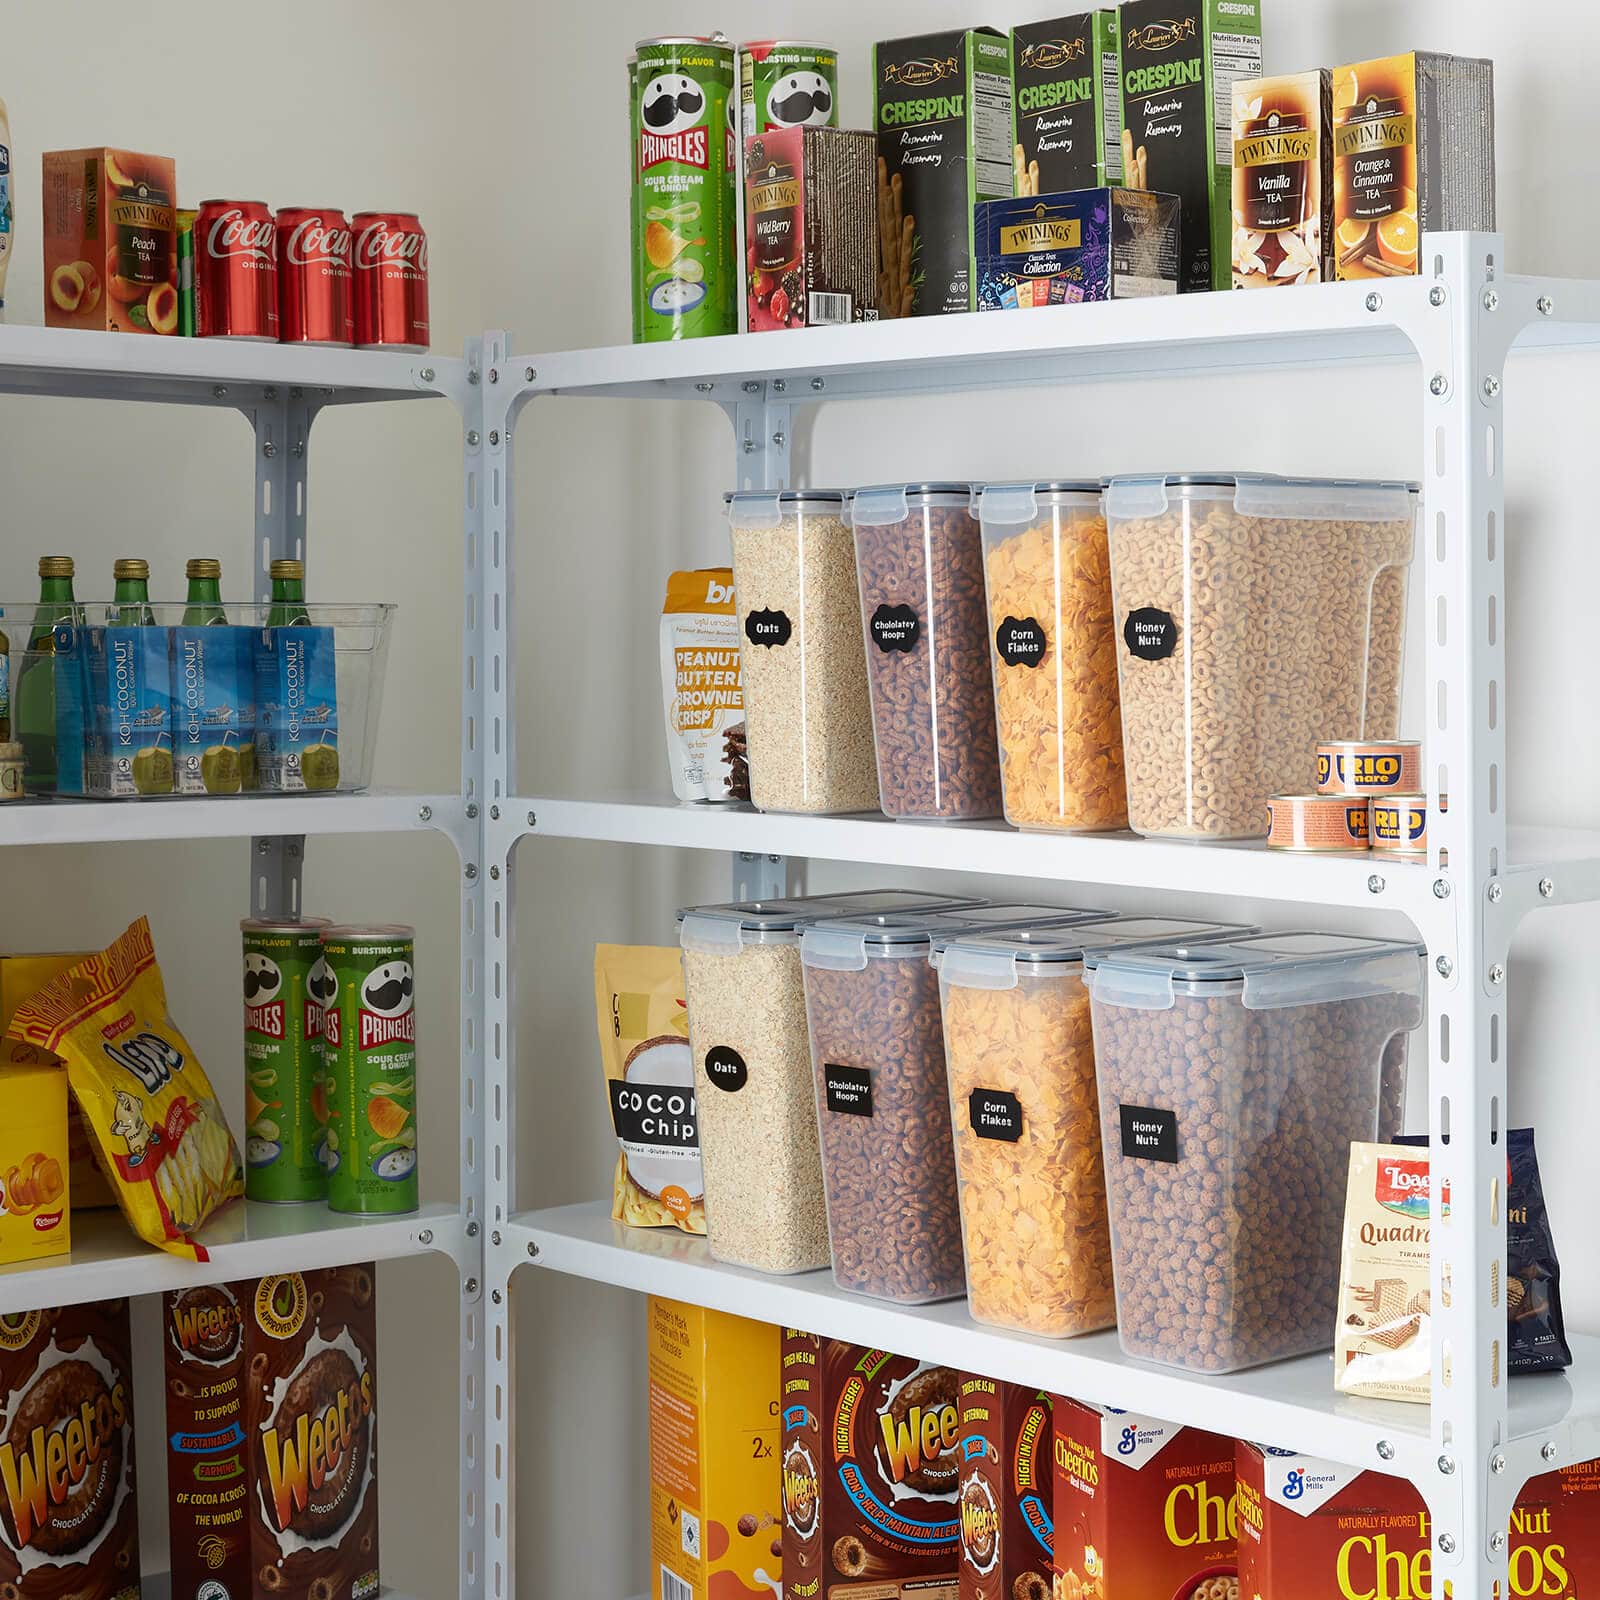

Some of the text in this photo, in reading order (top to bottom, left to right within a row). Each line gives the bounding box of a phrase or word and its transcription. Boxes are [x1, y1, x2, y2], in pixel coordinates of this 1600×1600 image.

[1217, 3, 1256, 17] CRESPINI
[1213, 34, 1260, 45] Nutrition Facts
[681, 58, 715, 68] FLAVOR
[1247, 63, 1261, 71] 130
[1125, 58, 1202, 94] CRESPINI
[1018, 76, 1093, 111] CRESPINI
[881, 95, 965, 125] CRESPINI
[1145, 122, 1182, 138] Rosemary
[1339, 124, 1407, 151] TWININGS
[642, 130, 706, 167] PRINGLES
[1037, 136, 1073, 153] Rosemary
[1239, 141, 1311, 164] TWININGS
[901, 151, 942, 167] Rosemary
[1354, 160, 1391, 173] Orange &
[644, 175, 704, 188] SOUR CREAM
[1258, 174, 1291, 191] Vanilla
[1352, 172, 1393, 188] Cinnamon
[661, 184, 690, 193] ONION
[1365, 189, 1381, 200] TEA
[751, 186, 797, 209] TWININGS
[1266, 193, 1282, 204] TEA
[113, 205, 171, 228] TWININGS
[757, 219, 791, 236] Wild Berry
[131, 236, 157, 251] Peach
[768, 235, 779, 246] TEA
[1010, 224, 1072, 248] TWININGS
[138, 251, 151, 262] TEA
[1023, 261, 1062, 275] Collection
[386, 271, 426, 282] ORIGINAL
[756, 624, 780, 635] Oats
[875, 620, 916, 631] Chololatey
[1135, 622, 1166, 635] Honey
[882, 630, 906, 640] Hoops
[1011, 629, 1034, 641] Corn
[1138, 635, 1162, 647] Nuts
[1007, 641, 1039, 654] Flakes
[676, 652, 740, 667] PEANUT
[676, 671, 736, 686] BUTTER
[115, 640, 132, 746] KOH COCONUT
[184, 640, 201, 744] KOH COCONUT
[285, 640, 300, 742] KOH COCONUT
[677, 690, 742, 706] BROWNIE
[677, 710, 711, 726] CRISP
[352, 946, 392, 955] BURSTING
[367, 1055, 393, 1064] SOUR
[714, 1061, 738, 1075] Oats
[828, 1079, 869, 1094] Chololatey
[836, 1090, 860, 1103] Hoops
[984, 1101, 1008, 1114] Corn
[980, 1113, 1013, 1128] Flakes
[1132, 1121, 1164, 1136] Honey
[1135, 1133, 1160, 1147] Nuts
[173, 1305, 242, 1350] Weetos
[260, 1310, 292, 1334] APPROVED
[210, 1378, 238, 1397] PROUD
[785, 1378, 810, 1395] AFTERNOON
[961, 1380, 996, 1396] TRIED ME AS AN
[194, 1399, 241, 1422] TO SUPPORT
[836, 1379, 861, 1454] HIGH IN FIBRE
[963, 1406, 989, 1425] AFTERNOON
[181, 1429, 237, 1449] SUSTAINABLE
[1138, 1428, 1164, 1438] General
[1138, 1436, 1153, 1445] Mills
[263, 1370, 372, 1533] Weetos
[753, 1437, 772, 1459] 2x
[1018, 1409, 1043, 1486] HIGH IN FIBRE
[0, 1383, 126, 1548] Weetos
[199, 1462, 237, 1477] FARMING
[1055, 1438, 1099, 1486] Cheerios
[1165, 1461, 1233, 1480] NATURALLY FLAVORED
[1305, 1474, 1336, 1483] General
[51, 1459, 109, 1529] CHOCOLATEY HOOPS
[177, 1483, 247, 1505] OF COCOA ACROSS
[783, 1468, 818, 1513] Weetos
[1305, 1482, 1324, 1490] Mills
[310, 1485, 349, 1515] CHOCOLATEY
[842, 1466, 932, 1539] IRON HELPS MAINTAIN
[195, 1508, 244, 1526] THE WORLD!
[1024, 1500, 1043, 1527] IRON
[1508, 1507, 1552, 1535] Nut
[961, 1501, 998, 1546] Weetos
[1338, 1515, 1417, 1529] NATURALLY FLAVORED
[908, 1547, 941, 1557] SATURATED
